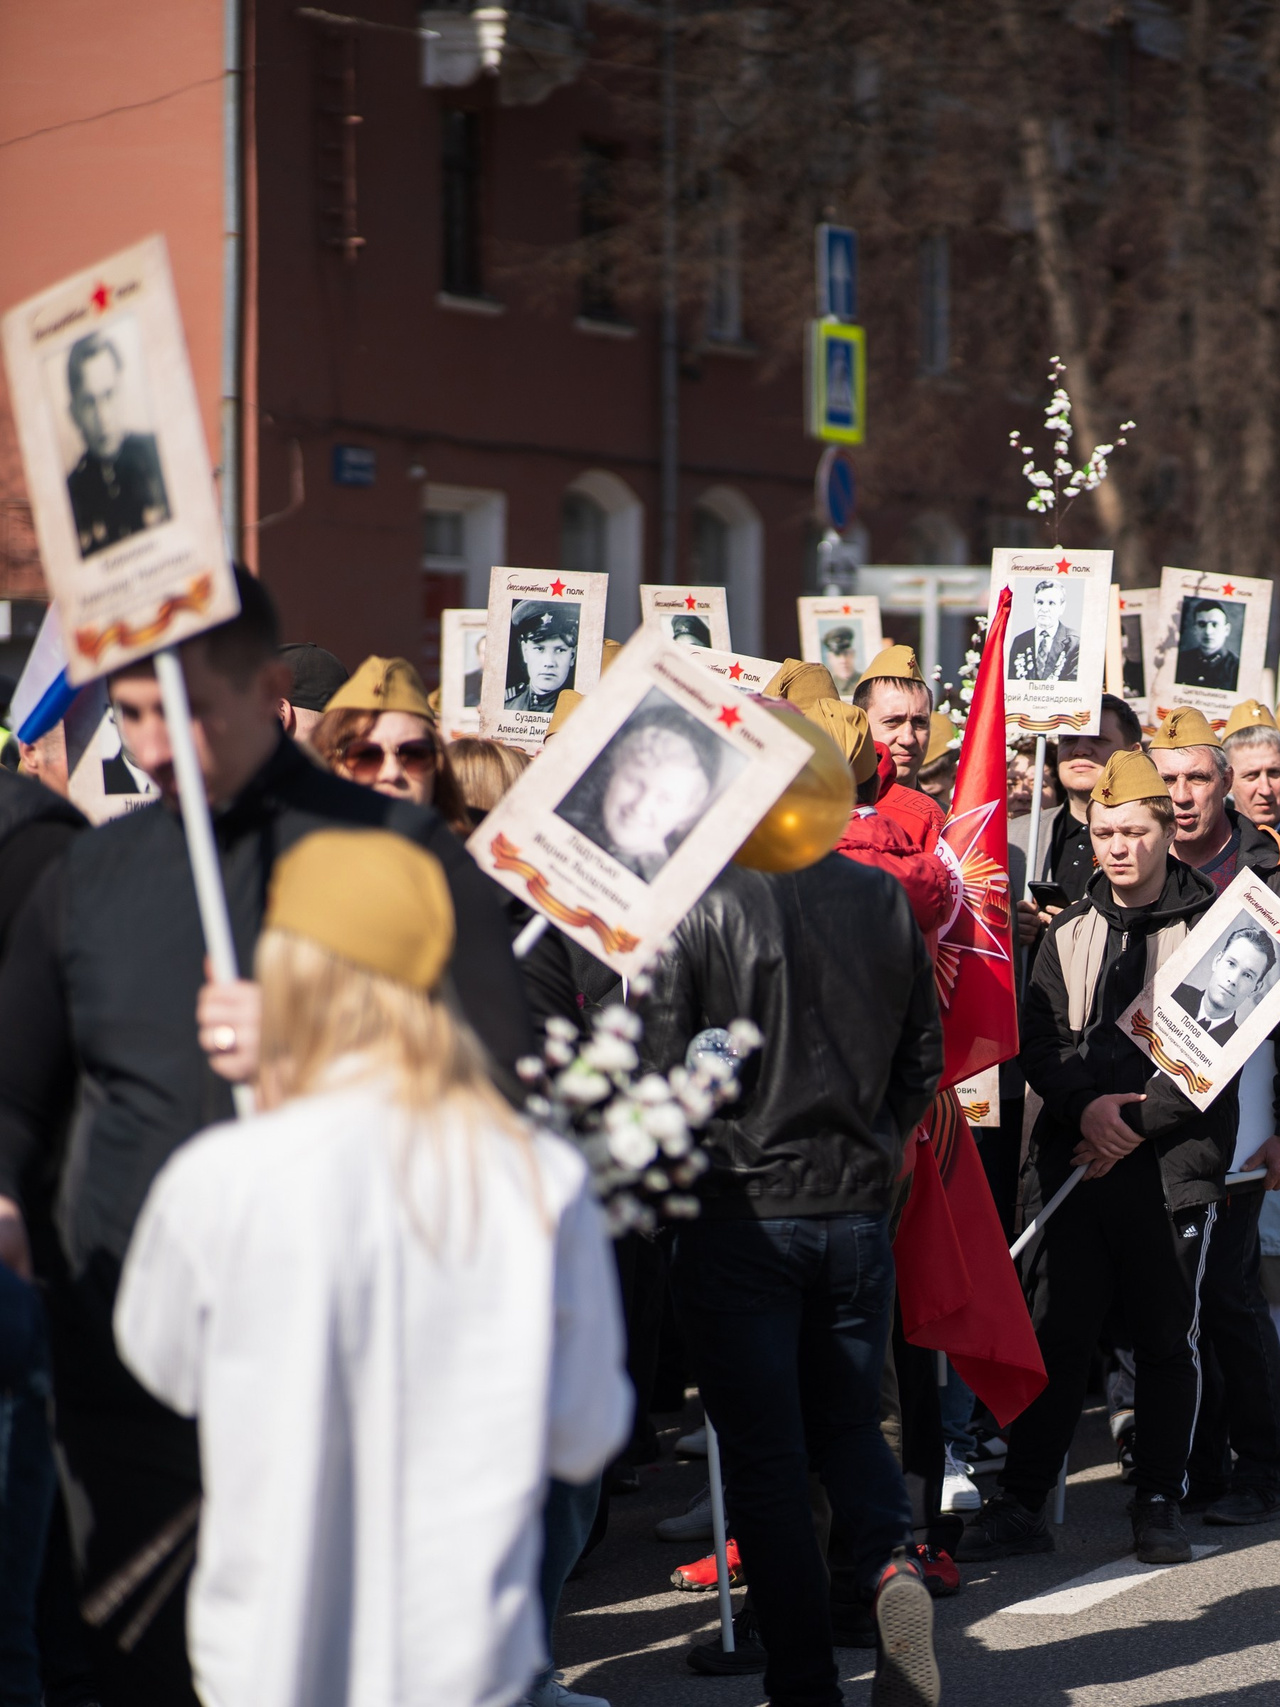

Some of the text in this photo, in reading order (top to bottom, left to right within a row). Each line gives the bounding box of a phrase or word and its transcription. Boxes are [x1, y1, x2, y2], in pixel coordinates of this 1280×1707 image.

[1072, 565, 1091, 573] полк
[566, 587, 585, 596] полк
[1029, 682, 1055, 691] Пылев
[1023, 694, 1083, 704] Александрович
[497, 723, 528, 734] Алексей
[1180, 1014, 1202, 1039] Попов
[1153, 1004, 1214, 1068] Геннадий Павлович
